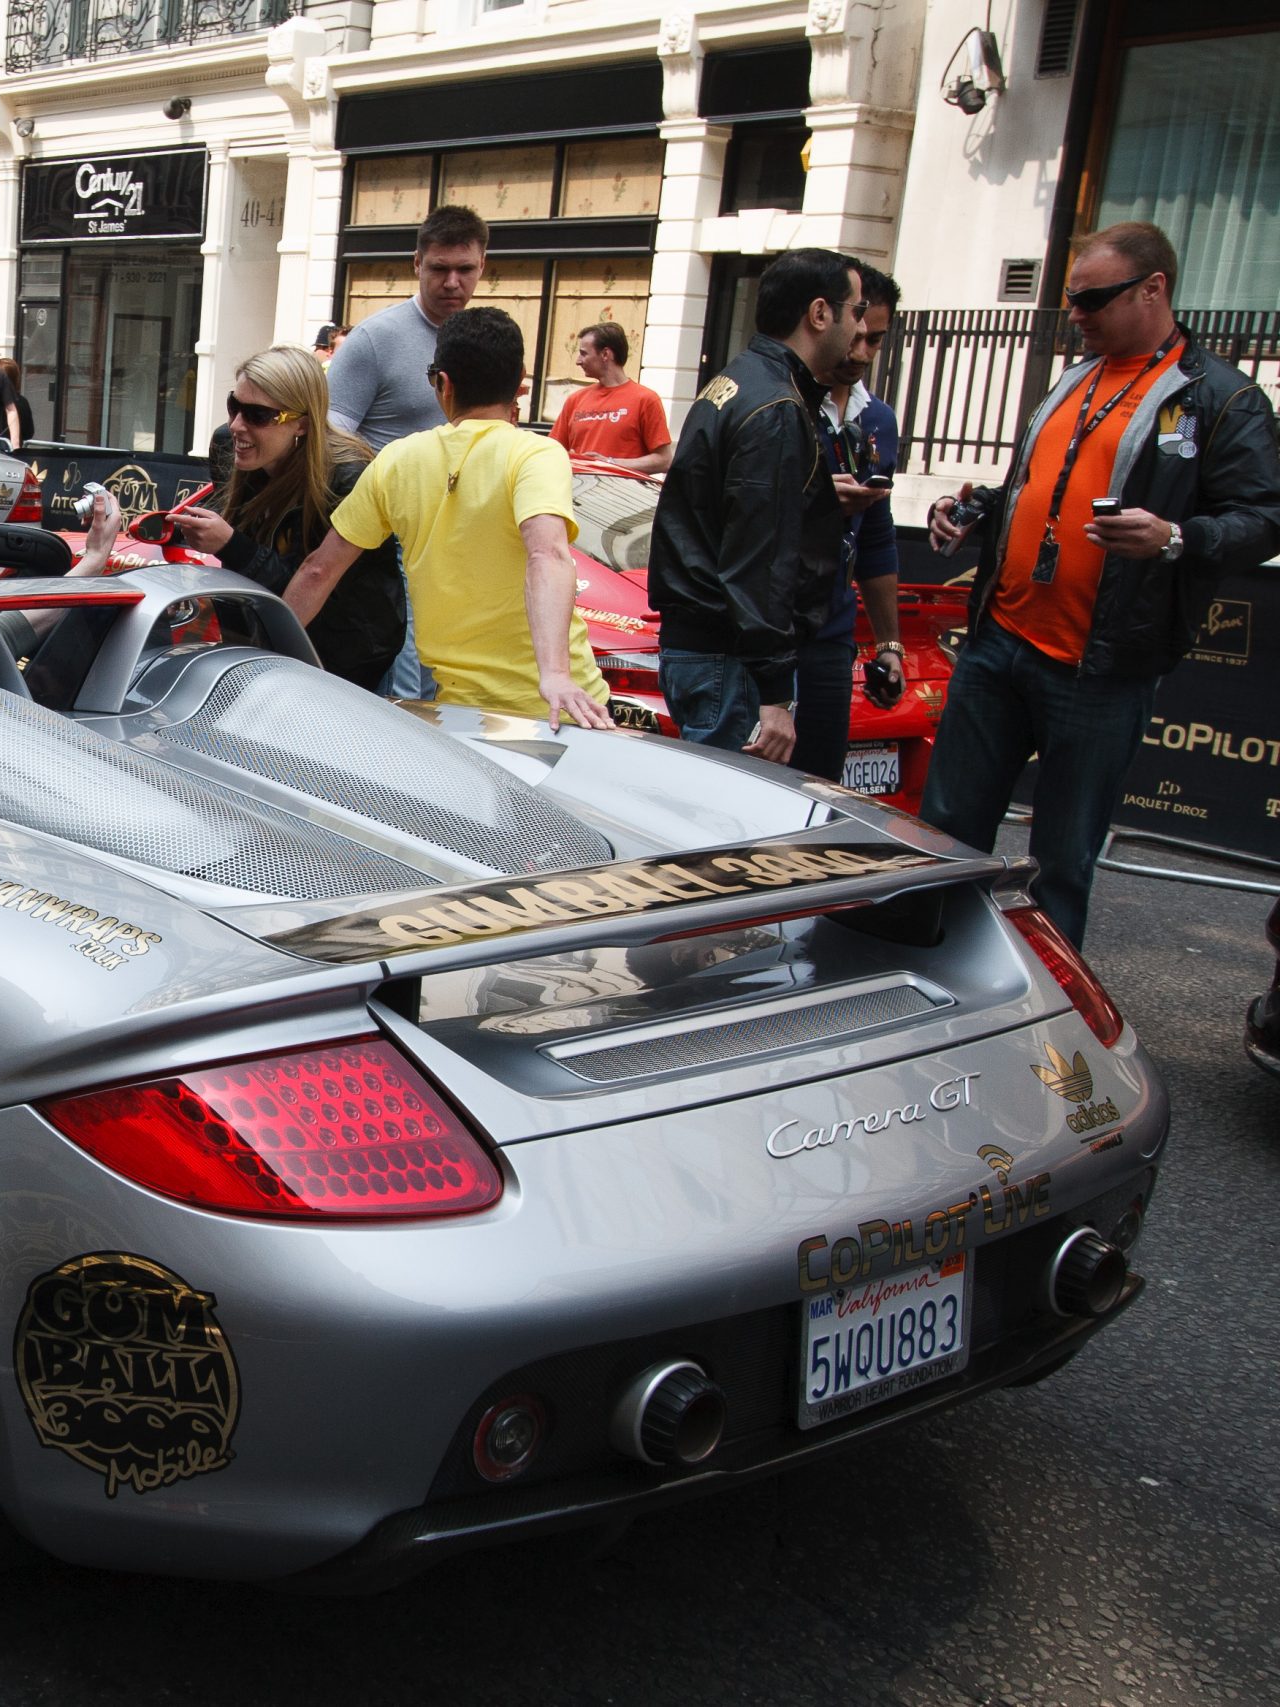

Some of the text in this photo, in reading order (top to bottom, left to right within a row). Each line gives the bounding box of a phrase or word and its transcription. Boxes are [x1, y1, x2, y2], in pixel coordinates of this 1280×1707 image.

[75, 163, 133, 199] Century
[88, 220, 98, 234] St
[840, 760, 897, 788] YGE026
[855, 785, 886, 795] ARLSEN
[1123, 793, 1209, 819] JAQUET DROZ
[379, 862, 753, 946] GUMBALL
[765, 1071, 982, 1159] Carrera GT
[1065, 1095, 1121, 1134] adidas
[810, 1272, 940, 1319] MAR California
[811, 1294, 958, 1399] 5WQU883
[818, 1358, 953, 1418] WARRIOR HEART FOUNDATION
[106, 1440, 228, 1497] Mobile
